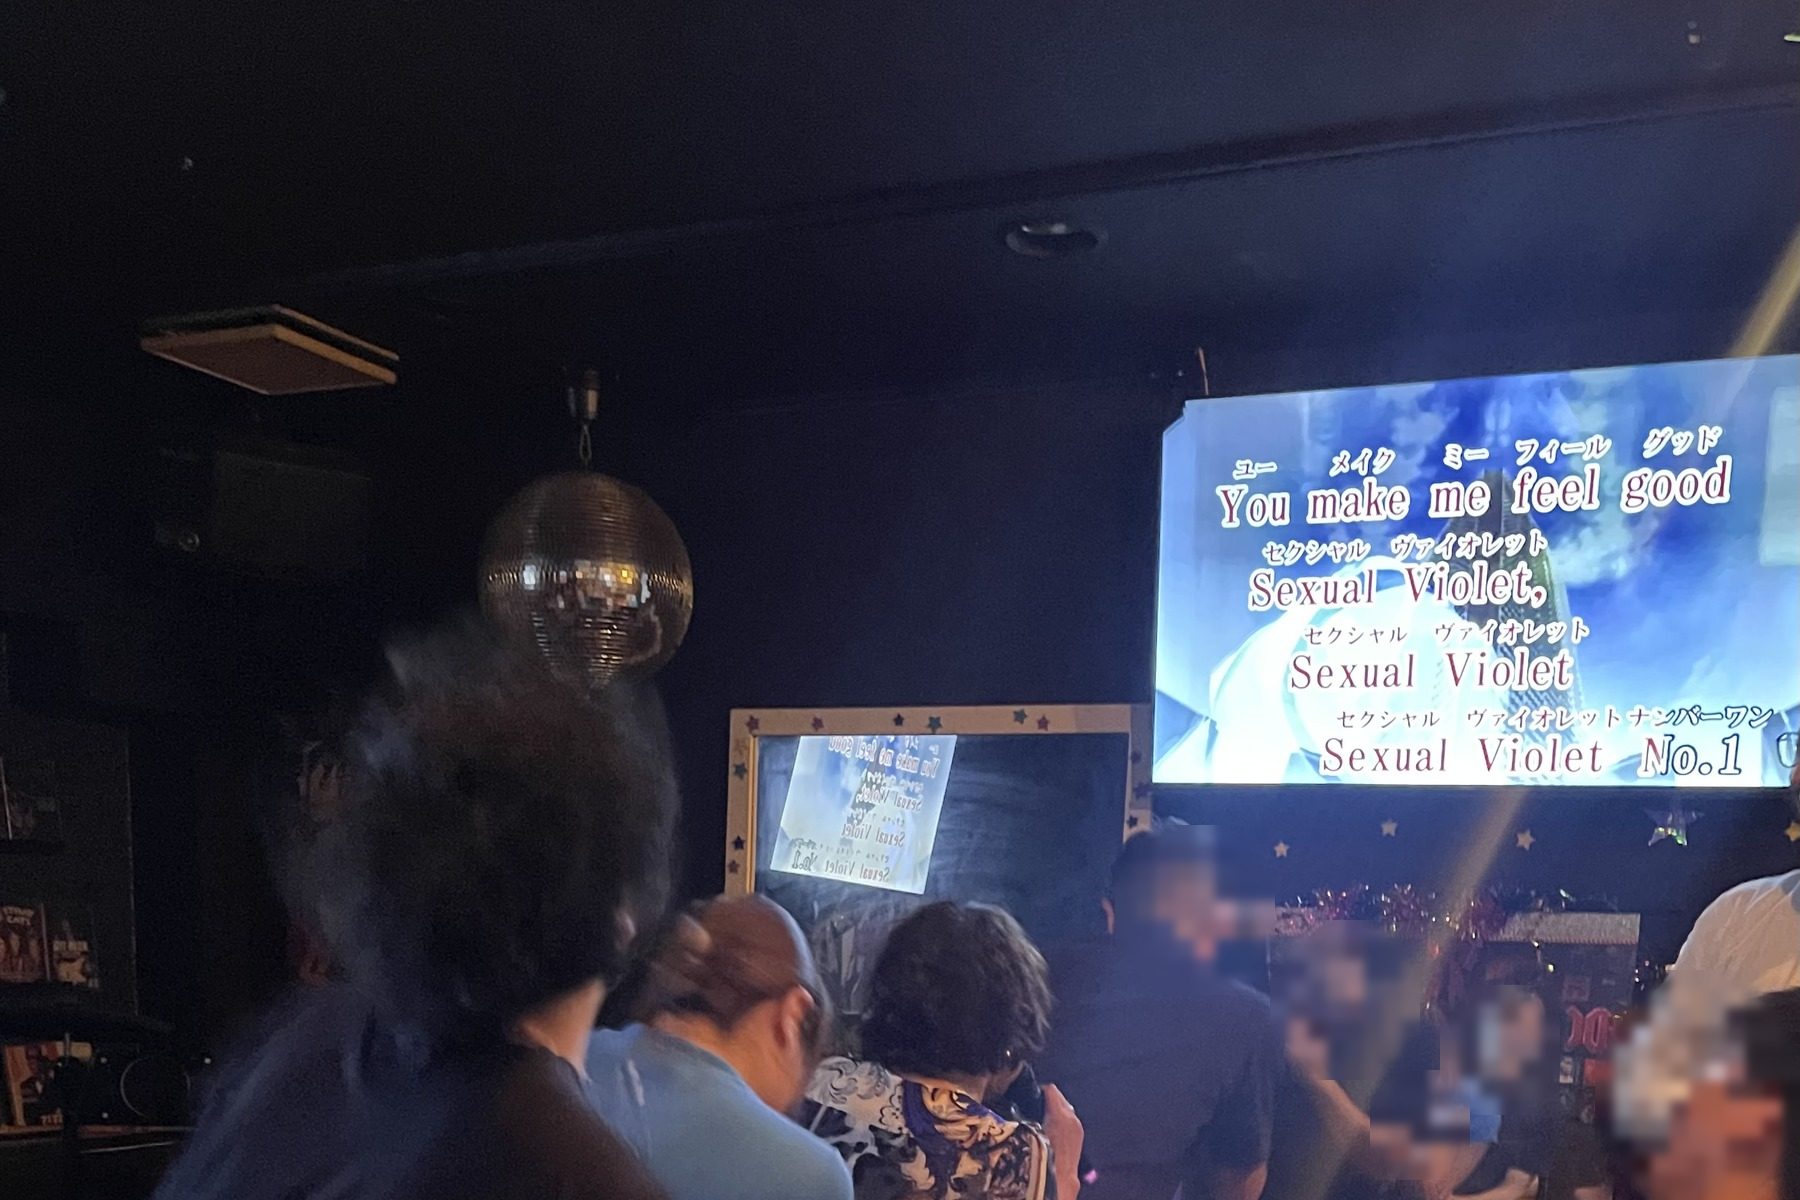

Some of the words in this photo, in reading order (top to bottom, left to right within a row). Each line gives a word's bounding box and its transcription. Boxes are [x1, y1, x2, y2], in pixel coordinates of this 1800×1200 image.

[1234, 461, 1276, 478] ユー
[1330, 449, 1394, 475] メイク
[1445, 445, 1489, 469] ミー
[1516, 436, 1610, 463] フィール
[1644, 427, 1721, 456] グッド
[1219, 486, 1288, 525] You
[1309, 479, 1408, 521] make
[1431, 484, 1488, 515] me
[1514, 466, 1598, 510] feel
[1623, 458, 1730, 511] good
[1264, 541, 1369, 564] セクシャル
[1392, 530, 1546, 559] ヴァイオレット
[1250, 567, 1375, 609] Sexual
[1404, 562, 1545, 605] Violet,
[1304, 625, 1408, 646] セクシャル
[1435, 619, 1588, 643] ヴァイオレット
[1290, 653, 1415, 690] Sexual
[1445, 650, 1571, 688] Violet
[1336, 709, 1441, 729] セクシャル
[1322, 737, 1447, 773] Sexual
[1478, 736, 1603, 773] Violet
[1642, 733, 1743, 776] No.1
